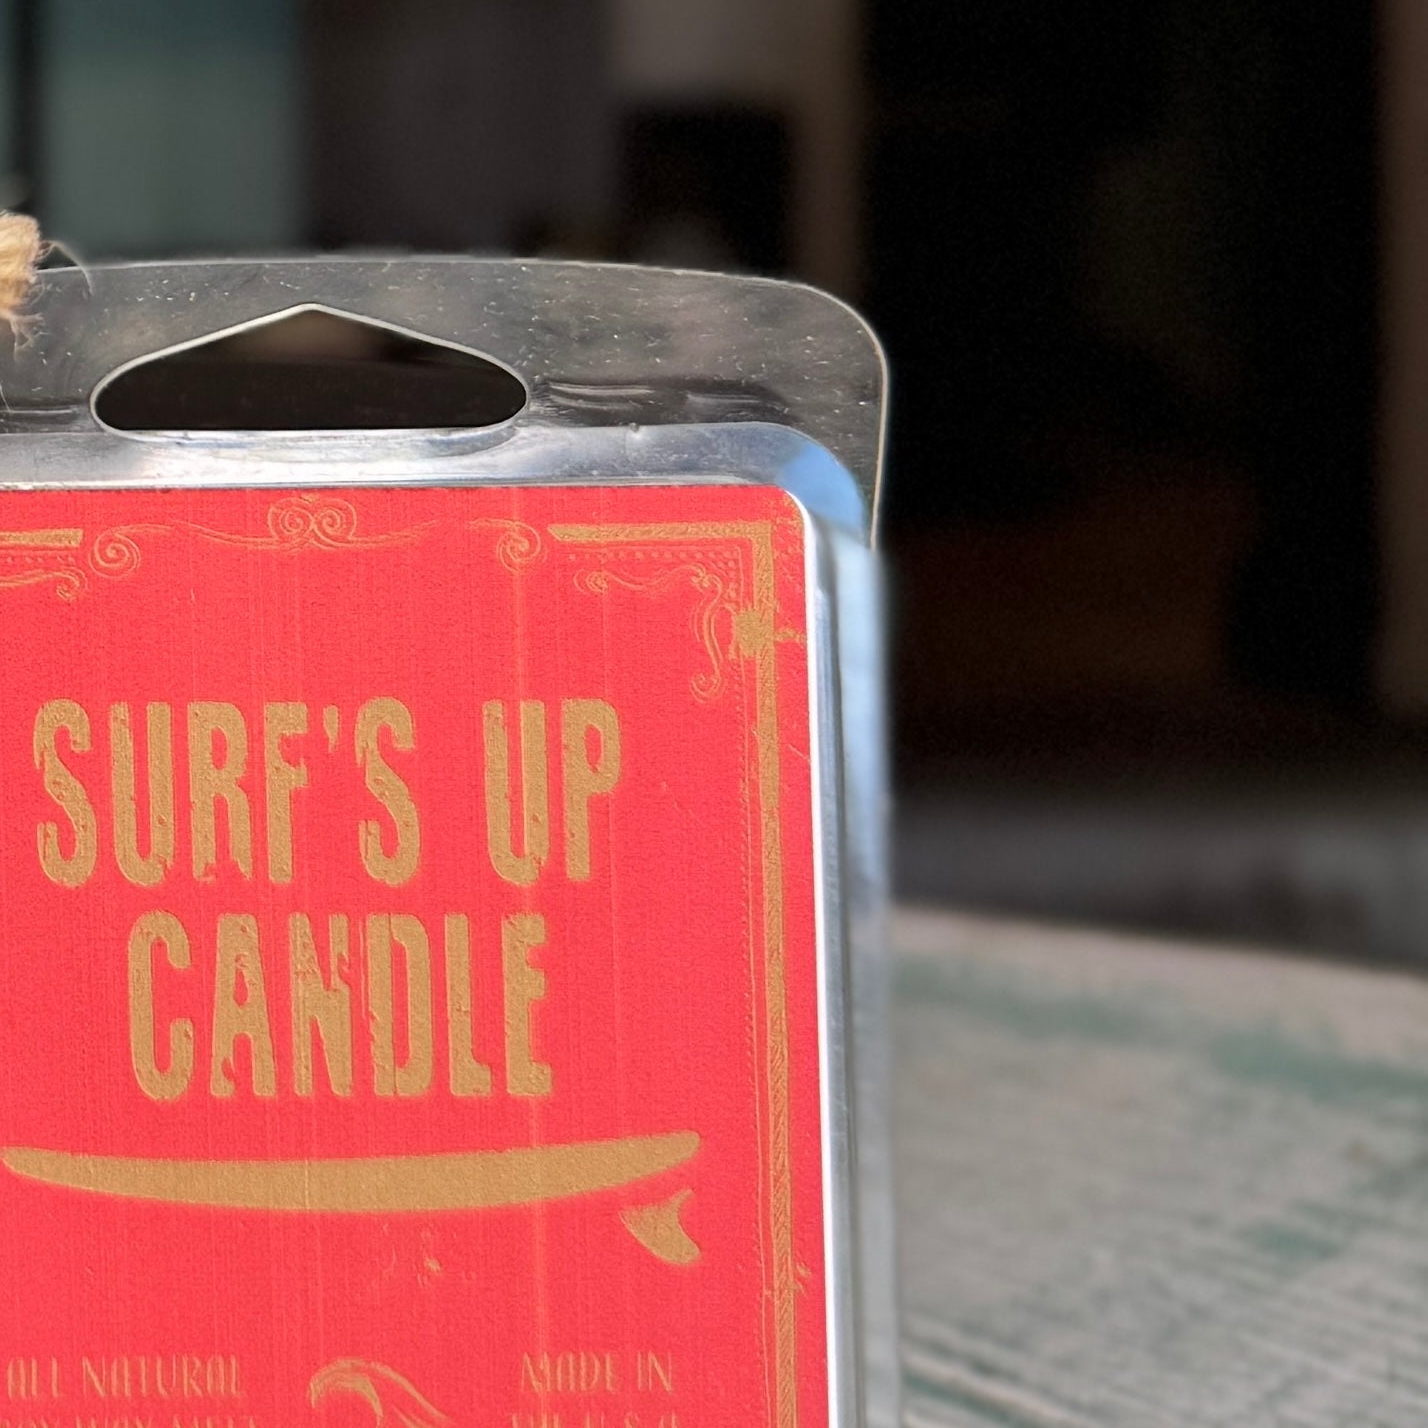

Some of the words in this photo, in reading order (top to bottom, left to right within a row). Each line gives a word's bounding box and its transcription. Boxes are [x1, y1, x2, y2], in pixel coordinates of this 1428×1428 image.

[34, 696, 420, 889] SURF'S
[484, 696, 623, 886] UP
[126, 910, 553, 1103] CANDLE
[7, 1355, 62, 1400] ALL
[80, 1355, 247, 1399] NATURAL
[520, 1351, 621, 1395] MADE
[638, 1351, 673, 1394] IN
